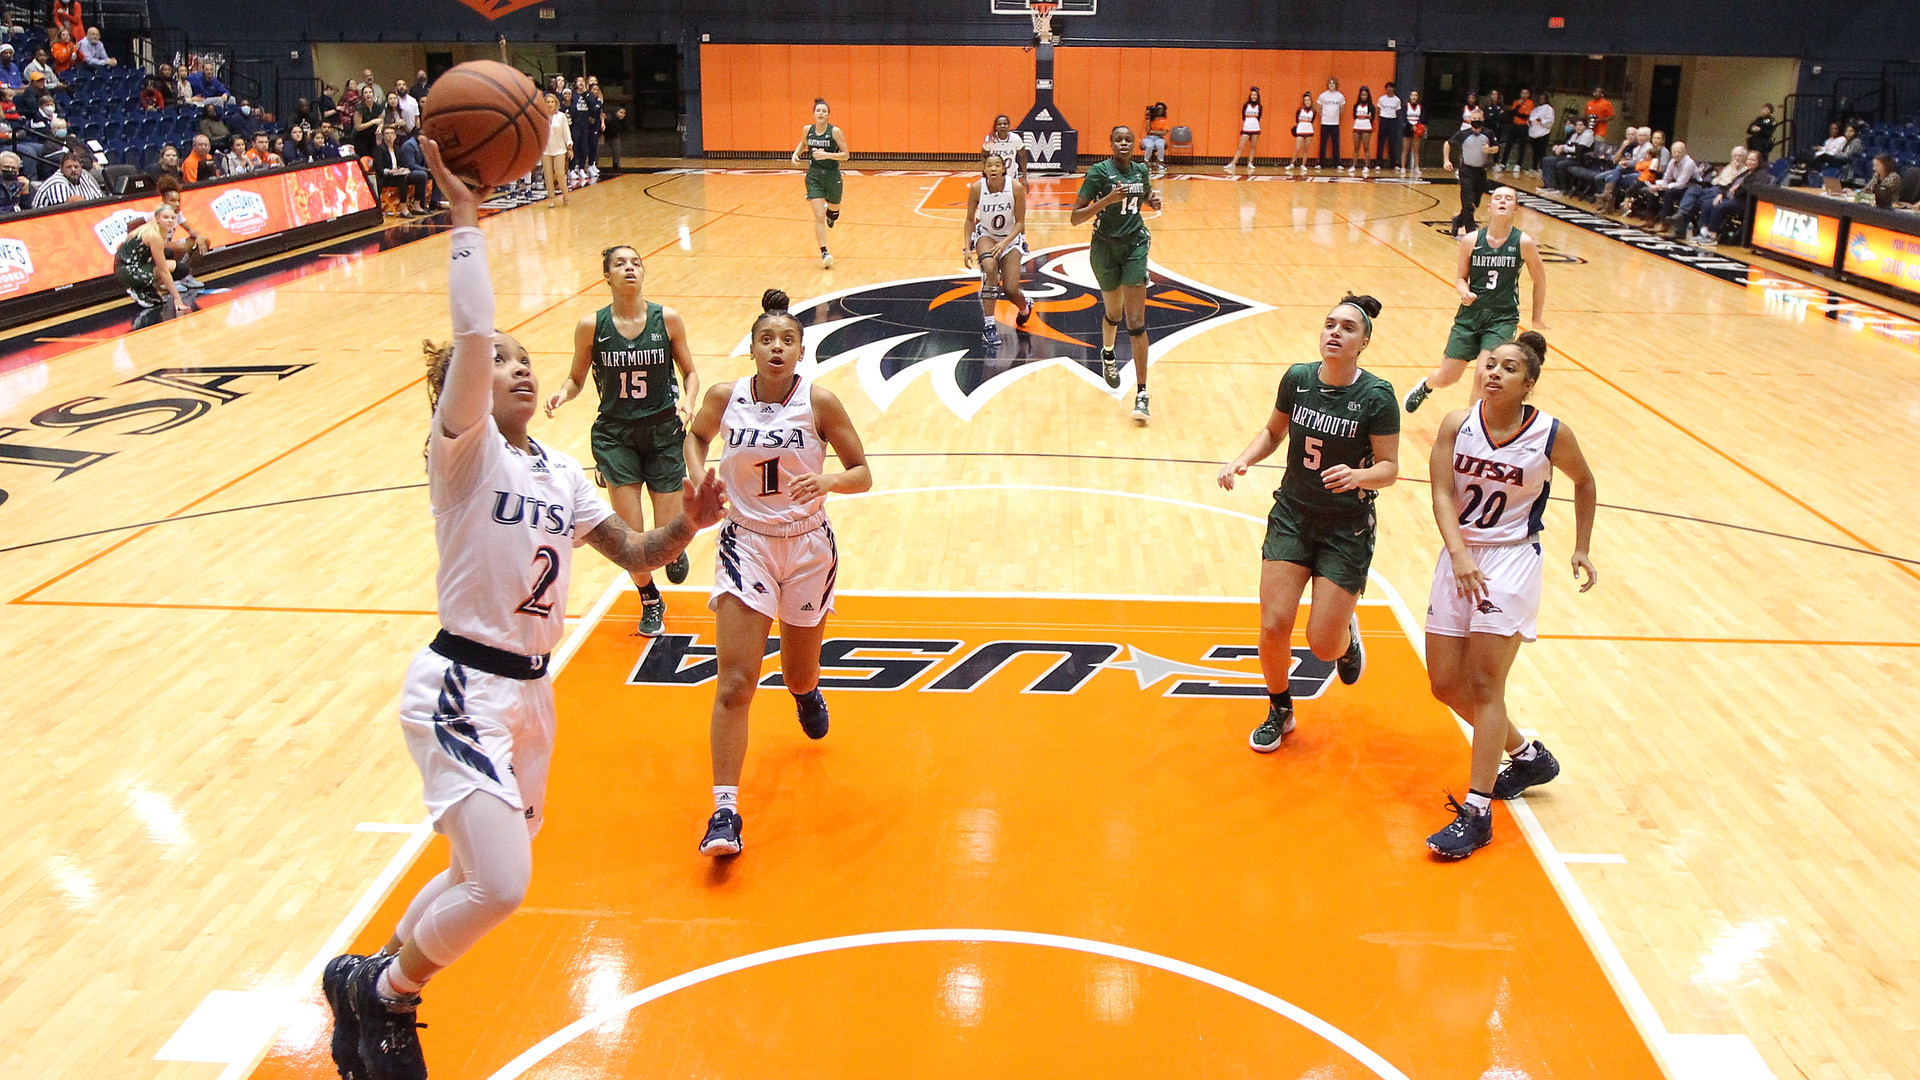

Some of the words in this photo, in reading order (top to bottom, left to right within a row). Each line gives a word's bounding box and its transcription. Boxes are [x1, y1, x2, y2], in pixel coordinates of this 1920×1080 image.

[982, 202, 1012, 213] UTSA
[1120, 197, 1138, 215] 14
[991, 214, 1006, 230] 0
[1771, 208, 1818, 246] UTSA
[1472, 255, 1516, 267] DARTMOUTH
[1486, 270, 1499, 290] 3
[601, 348, 665, 367] DARTMOUTH
[619, 370, 648, 399] 15
[0, 362, 319, 507] TSA
[728, 428, 805, 449] UTSA
[1303, 436, 1324, 471] 5
[753, 456, 782, 498] 1
[1453, 453, 1524, 487] UTSA
[1458, 484, 1507, 529] 20
[514, 545, 560, 619] 2
